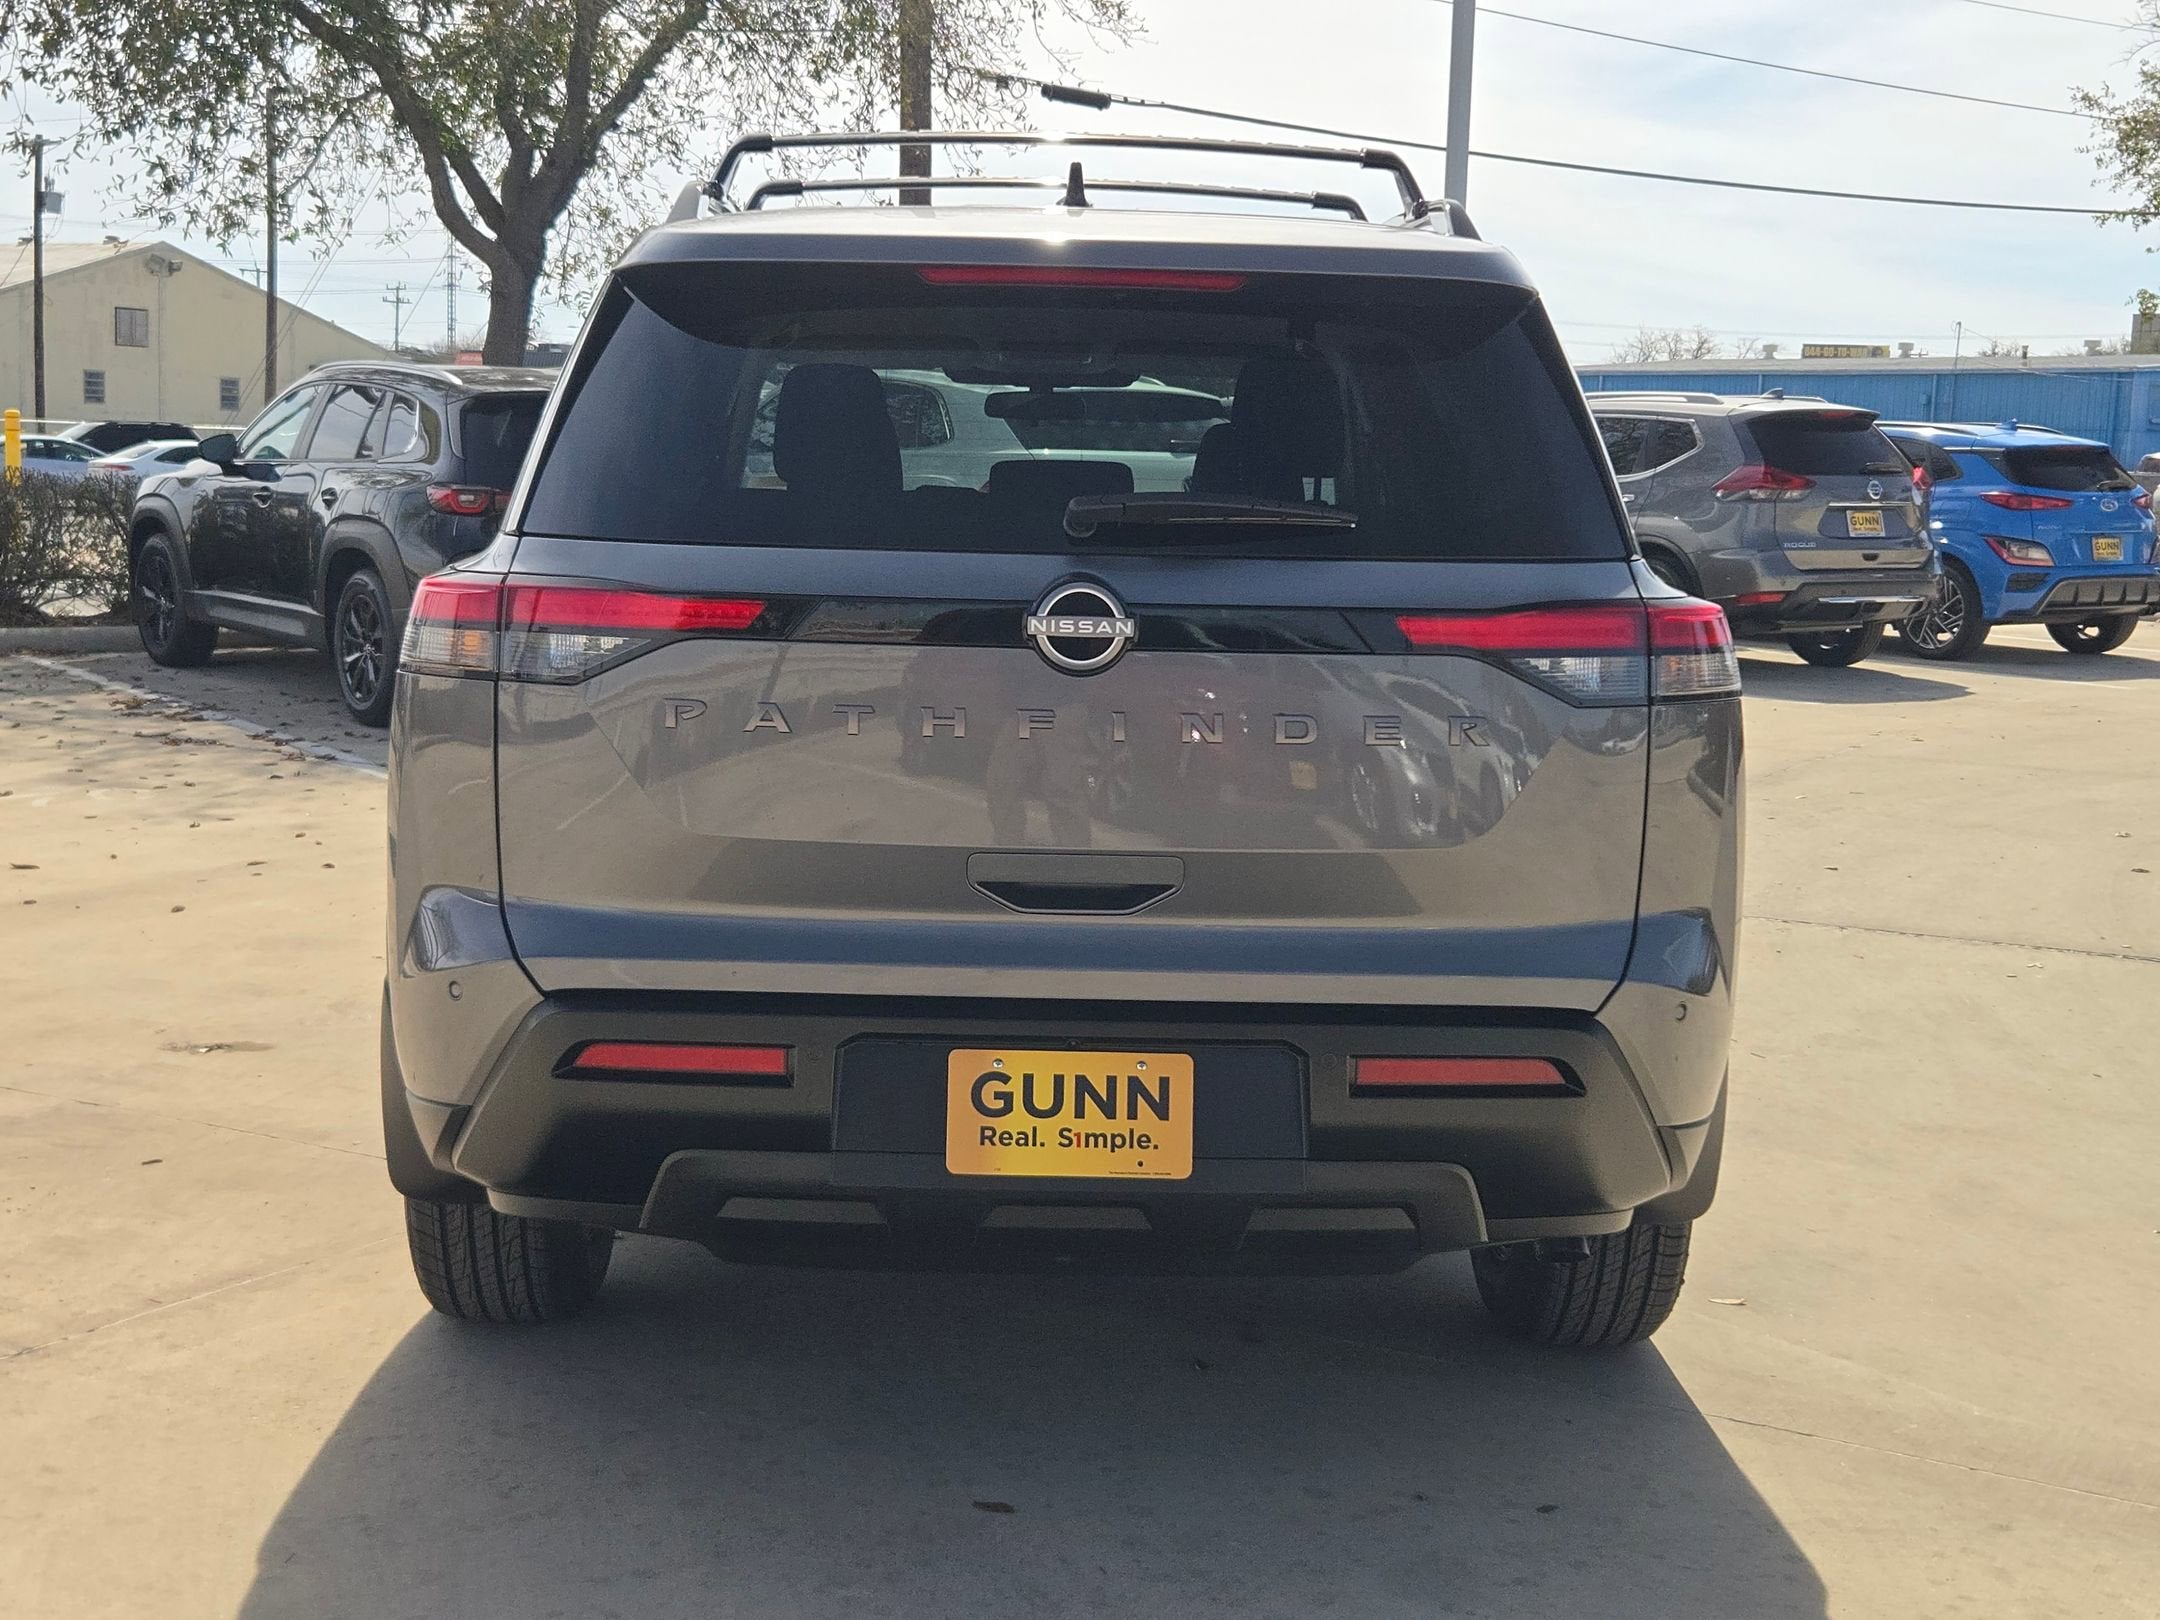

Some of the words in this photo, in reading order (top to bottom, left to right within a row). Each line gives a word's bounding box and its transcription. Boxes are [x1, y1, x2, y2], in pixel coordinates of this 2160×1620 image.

[1850, 515, 1880, 526] GUNN
[2095, 541, 2119, 551] GUNN
[1030, 619, 1132, 634] NISSAN
[664, 697, 1490, 747] PATHFINDER
[970, 1070, 1171, 1122] GUNN
[979, 1125, 1046, 1148] Real.
